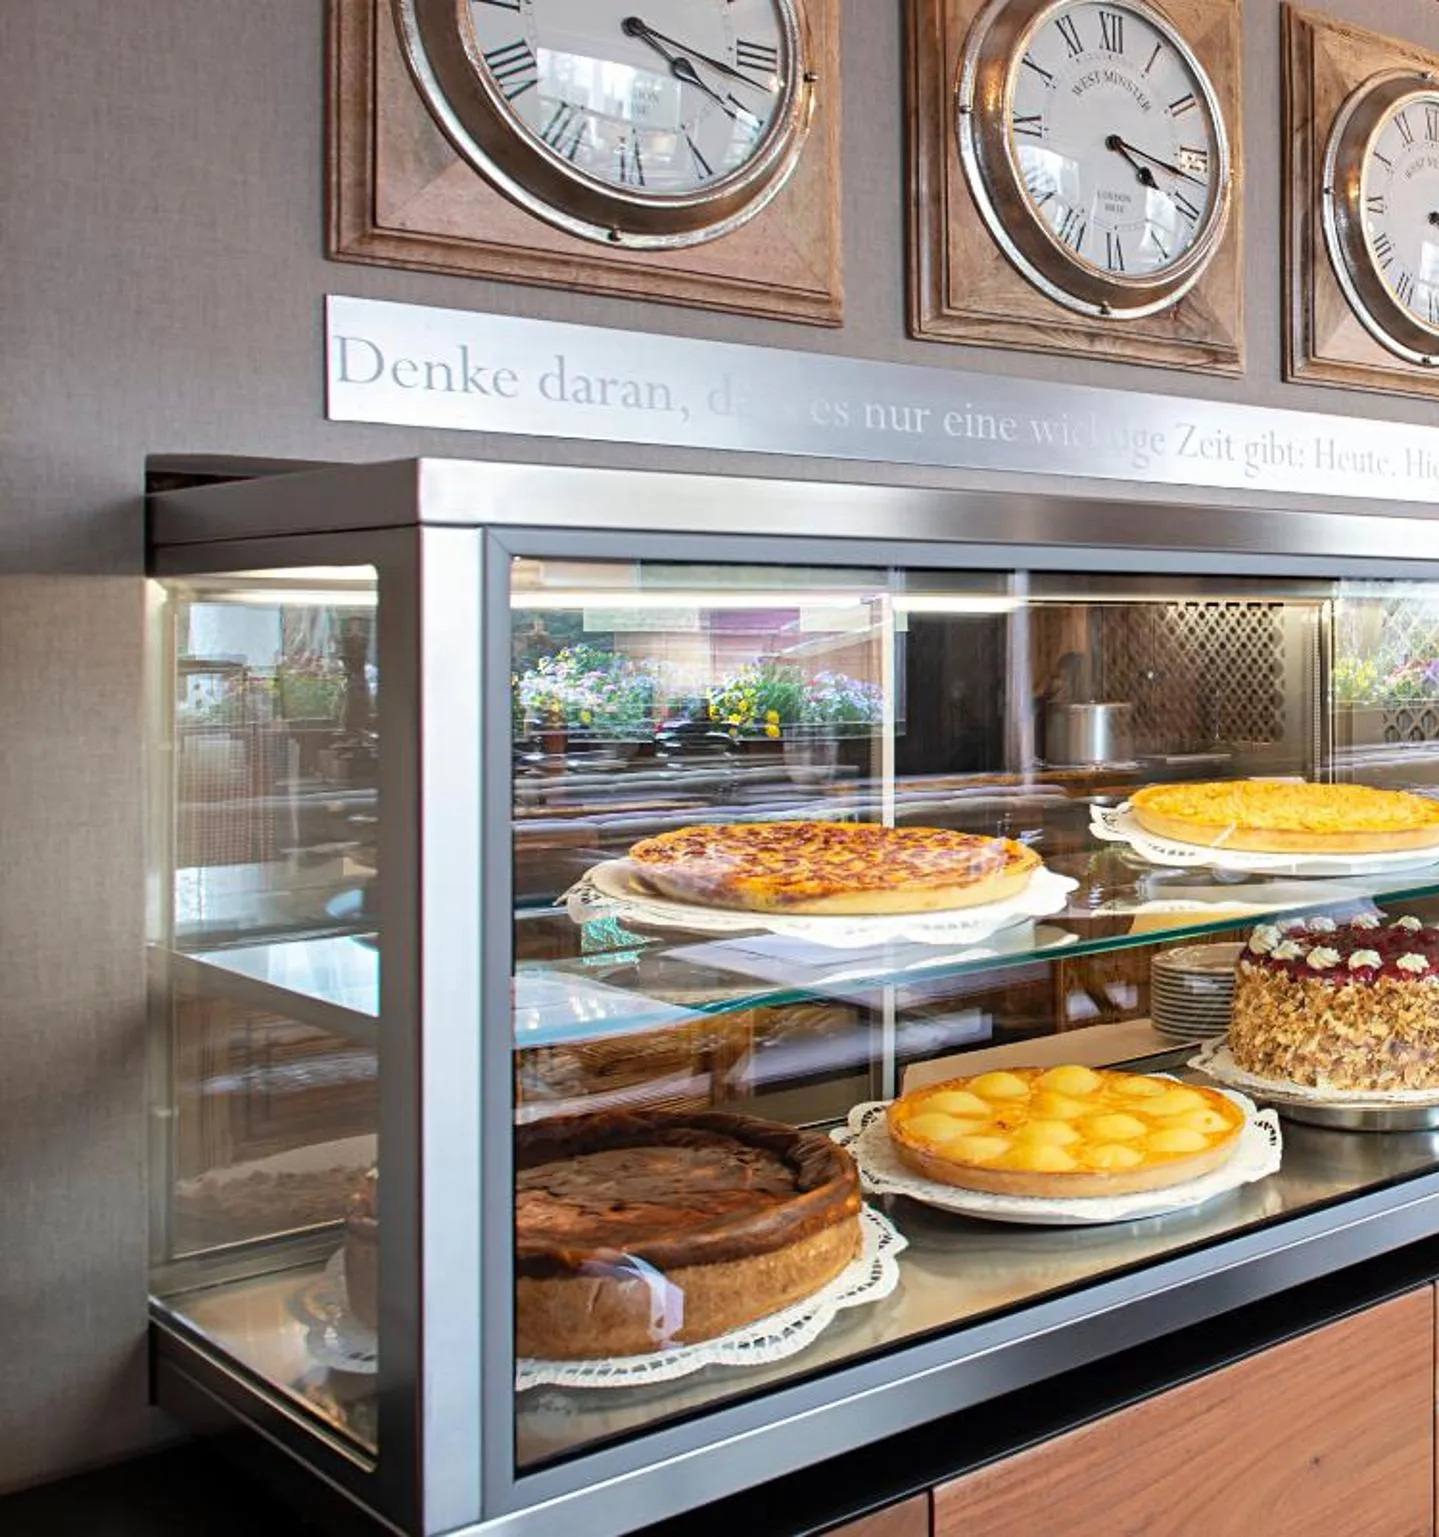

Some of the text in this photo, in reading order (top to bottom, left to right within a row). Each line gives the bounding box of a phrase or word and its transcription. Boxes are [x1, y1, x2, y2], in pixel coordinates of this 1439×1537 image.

[1099, 11, 1123, 54] XII
[333, 335, 519, 398] Denke
[538, 355, 691, 422] daran,
[809, 399, 850, 427] es
[865, 402, 932, 434] nur
[943, 402, 1017, 442] eine
[1176, 422, 1236, 461] Zeit
[1243, 429, 1305, 478] gibt:
[1313, 436, 1397, 477] Heute.
